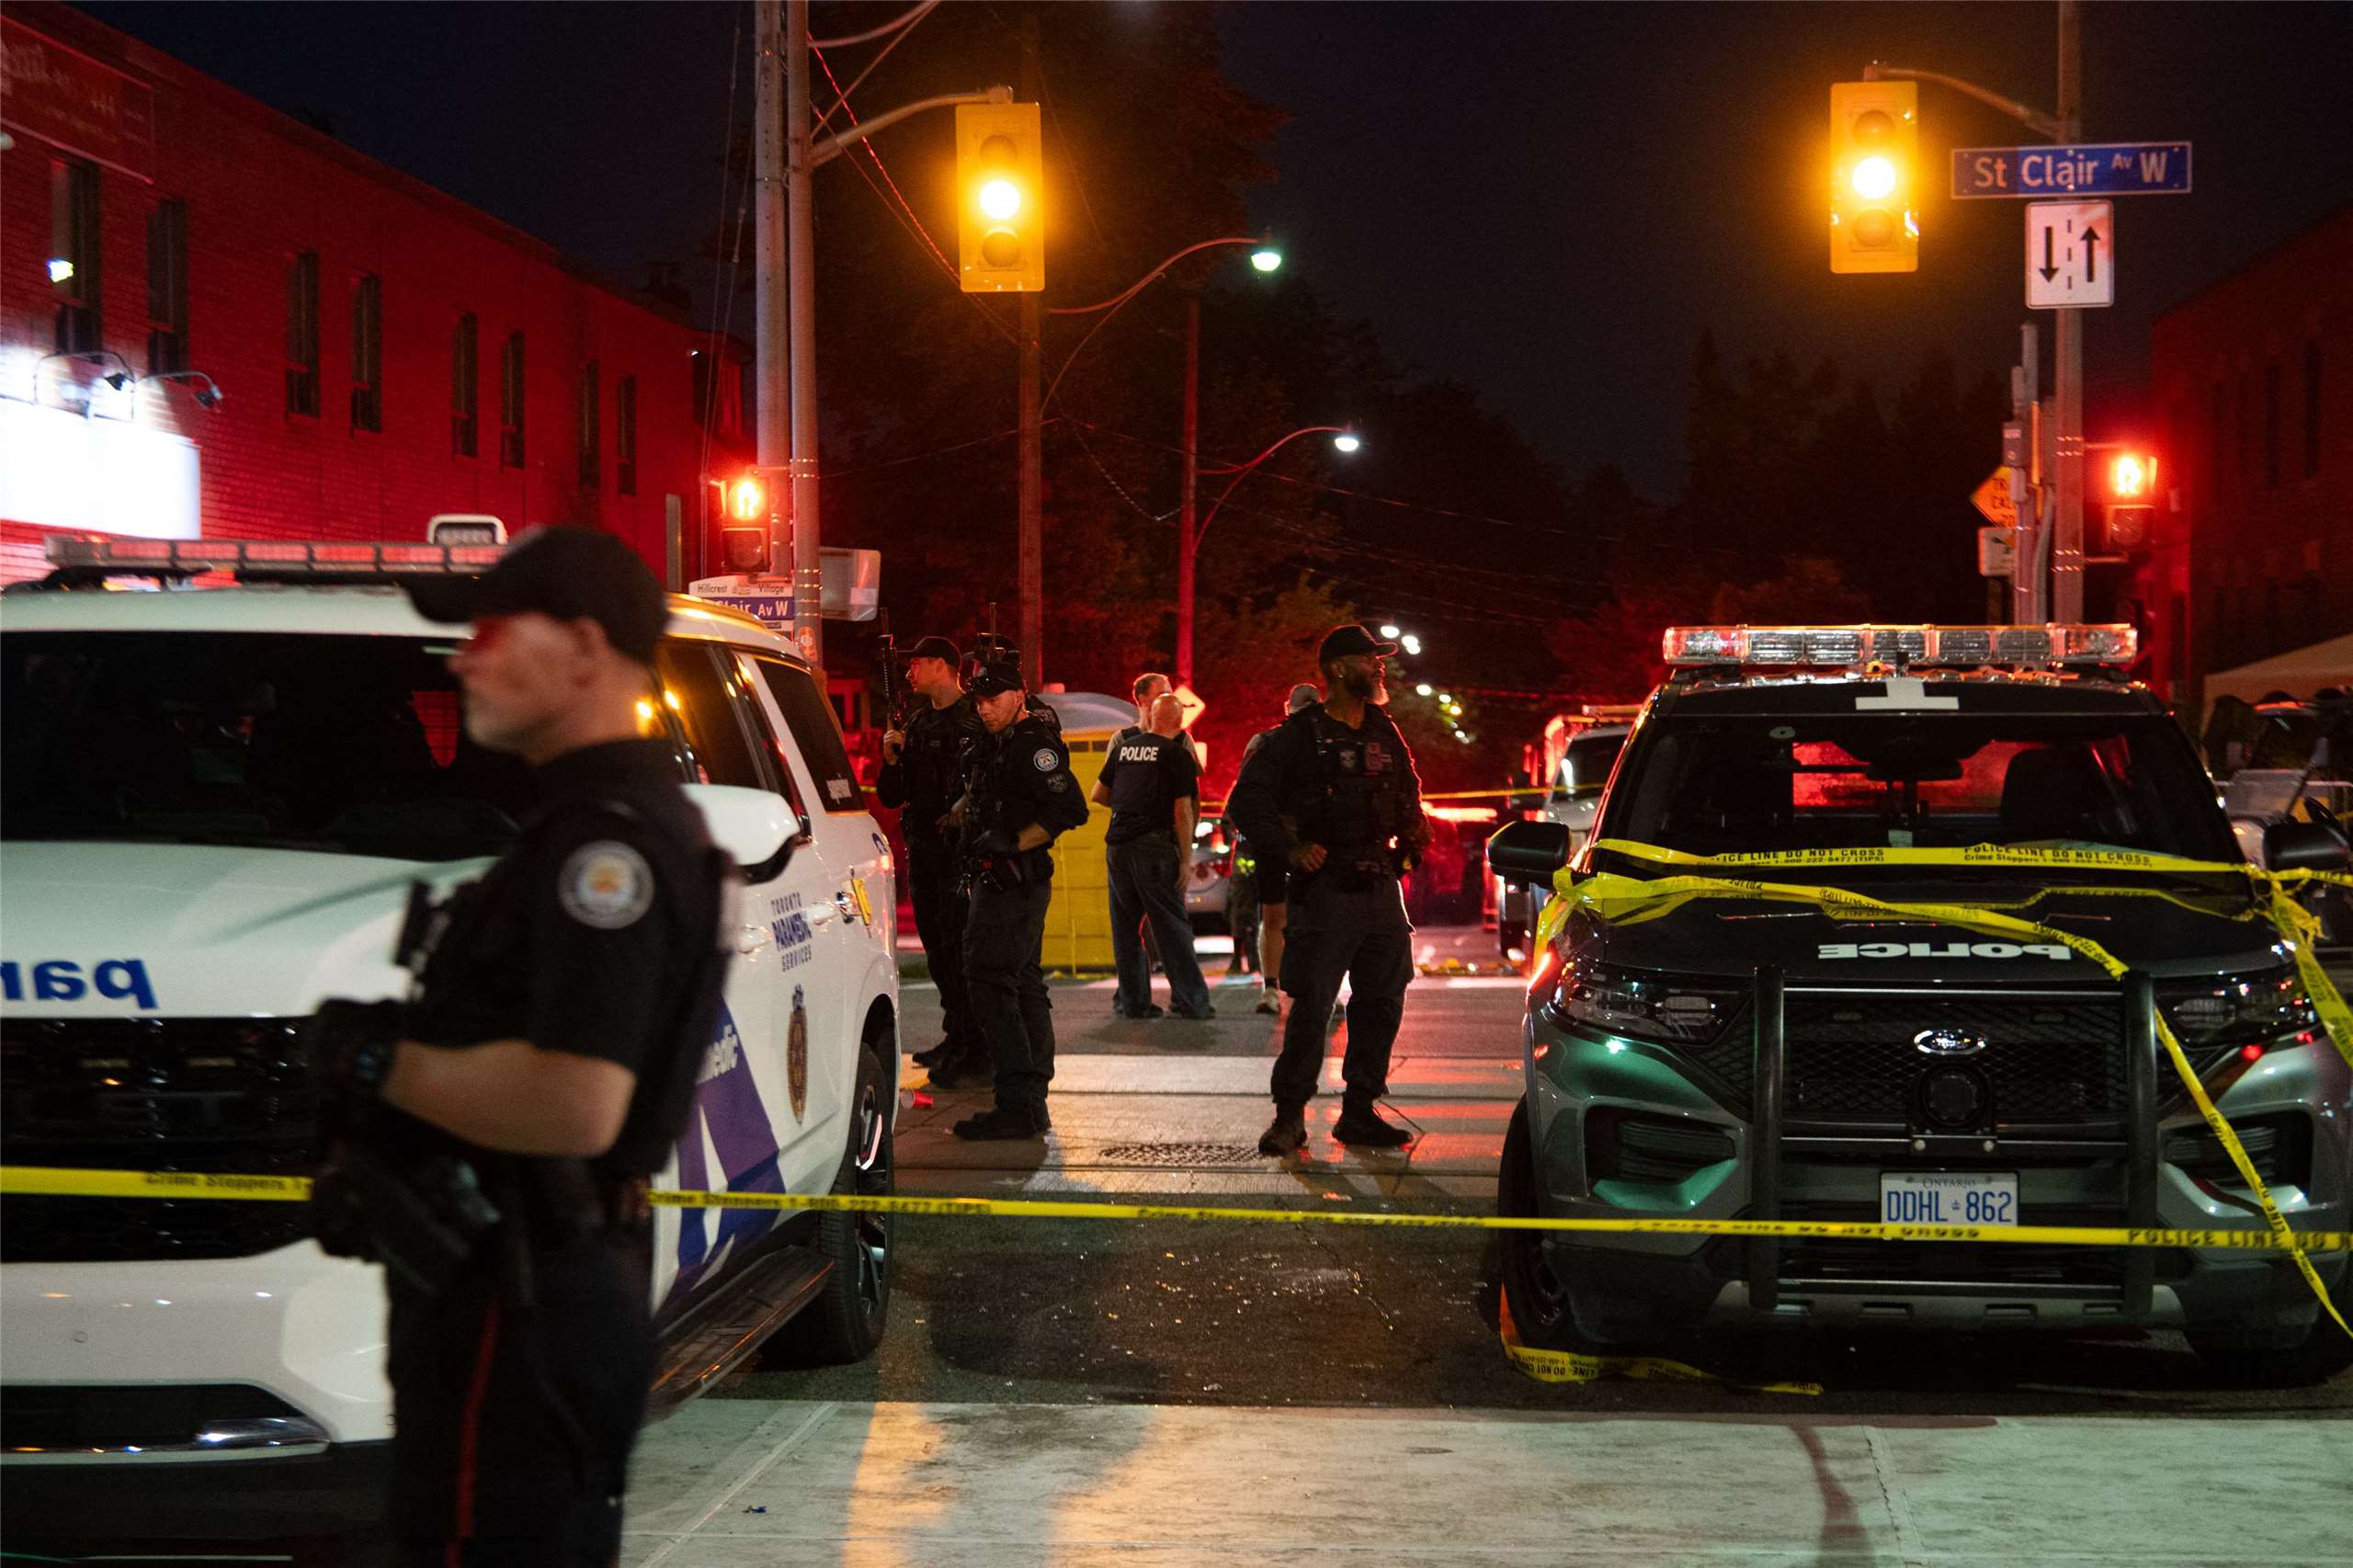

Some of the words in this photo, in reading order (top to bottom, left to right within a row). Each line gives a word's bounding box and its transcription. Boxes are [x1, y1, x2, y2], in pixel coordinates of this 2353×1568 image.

[1975, 157, 2007, 188] St
[2021, 154, 2099, 187] Clair
[2111, 153, 2133, 170] Av
[2141, 151, 2167, 184] W
[698, 584, 728, 594] Hillcrest
[758, 584, 784, 596] Village
[757, 604, 773, 617] Av
[775, 600, 789, 617] W
[1119, 745, 1159, 762] POLICE
[1750, 851, 1779, 861] LINE
[1786, 849, 1803, 858] DO
[1809, 848, 1835, 858] NOT
[1840, 847, 1884, 858] CROSS
[2018, 847, 2046, 857] LINE
[2052, 849, 2070, 859] DO
[2076, 850, 2102, 860] NOT
[2107, 852, 2152, 864] CROSS
[1922, 1176, 1977, 1189] ONTARIO
[1886, 1190, 1949, 1222] DDHL
[1965, 1190, 2012, 1223] 862
[2128, 1230, 2217, 1245] POLICE
